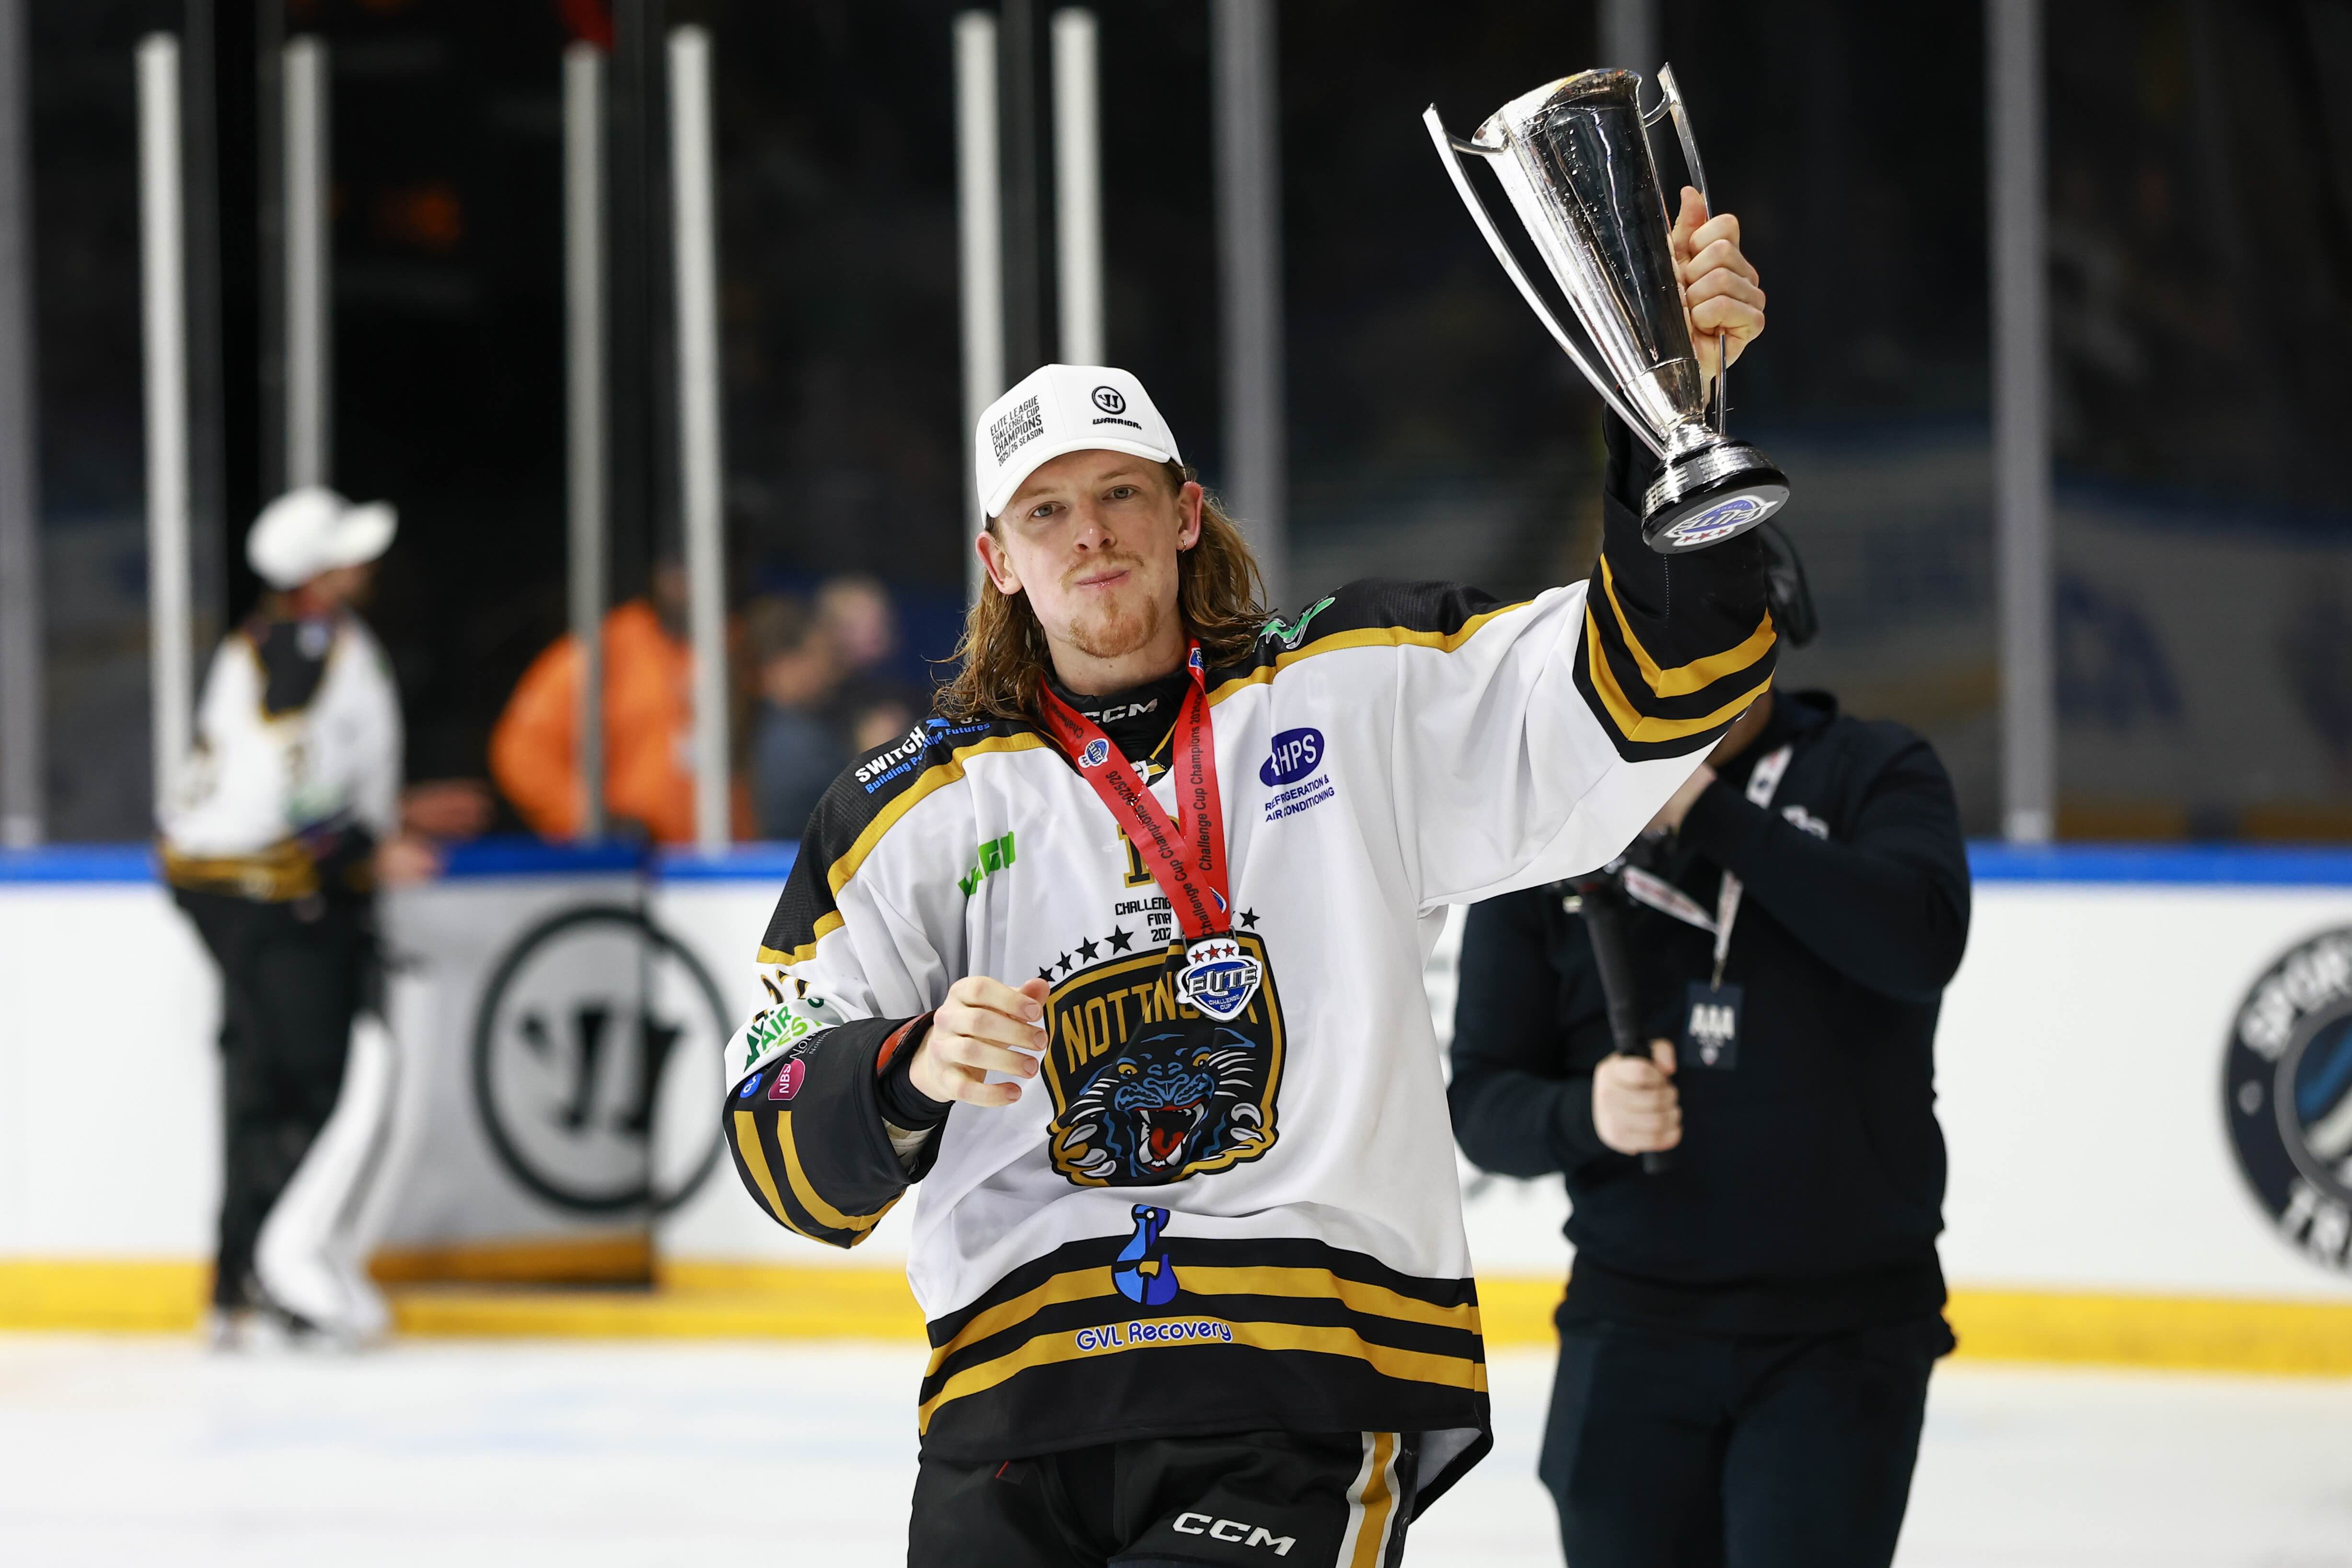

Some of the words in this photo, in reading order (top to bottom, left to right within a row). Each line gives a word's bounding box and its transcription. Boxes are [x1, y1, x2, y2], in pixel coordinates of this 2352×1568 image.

[990, 414, 1008, 436] ELITE
[1009, 395, 1039, 420] LEAGUE
[992, 414, 1025, 445] CHALLENGE
[1026, 405, 1040, 418] CUP
[1092, 418, 1140, 429] WARRIOR
[995, 414, 1042, 457] CHAMPIONS
[998, 441, 1018, 467] 2025/26
[1019, 426, 1044, 446] SEASON
[864, 762, 912, 794] Building
[945, 723, 990, 736] Futures
[1189, 726, 1204, 785] Champions
[1193, 789, 1208, 810] Cup
[1265, 777, 1323, 811] REFRGERATION
[1324, 774, 1330, 784] &
[1265, 809, 1283, 823] AIR
[1284, 787, 1335, 817] CONDITIONING
[1137, 804, 1174, 859] Champions
[1197, 813, 1212, 871] Challenge
[1171, 859, 1187, 881] Cup
[1114, 897, 1172, 916] CHALLENG
[1147, 913, 1171, 926] FINA
[1183, 882, 1215, 935] Challenge
[1151, 928, 1171, 942] 202
[1186, 964, 1258, 998] ELITE
[1208, 994, 1241, 1006] CHALLENGE
[761, 1006, 792, 1051] AIR
[1077, 1326, 1123, 1350] GVL
[1129, 1321, 1232, 1342] Recovery
[1172, 1512, 1297, 1556] CCM
